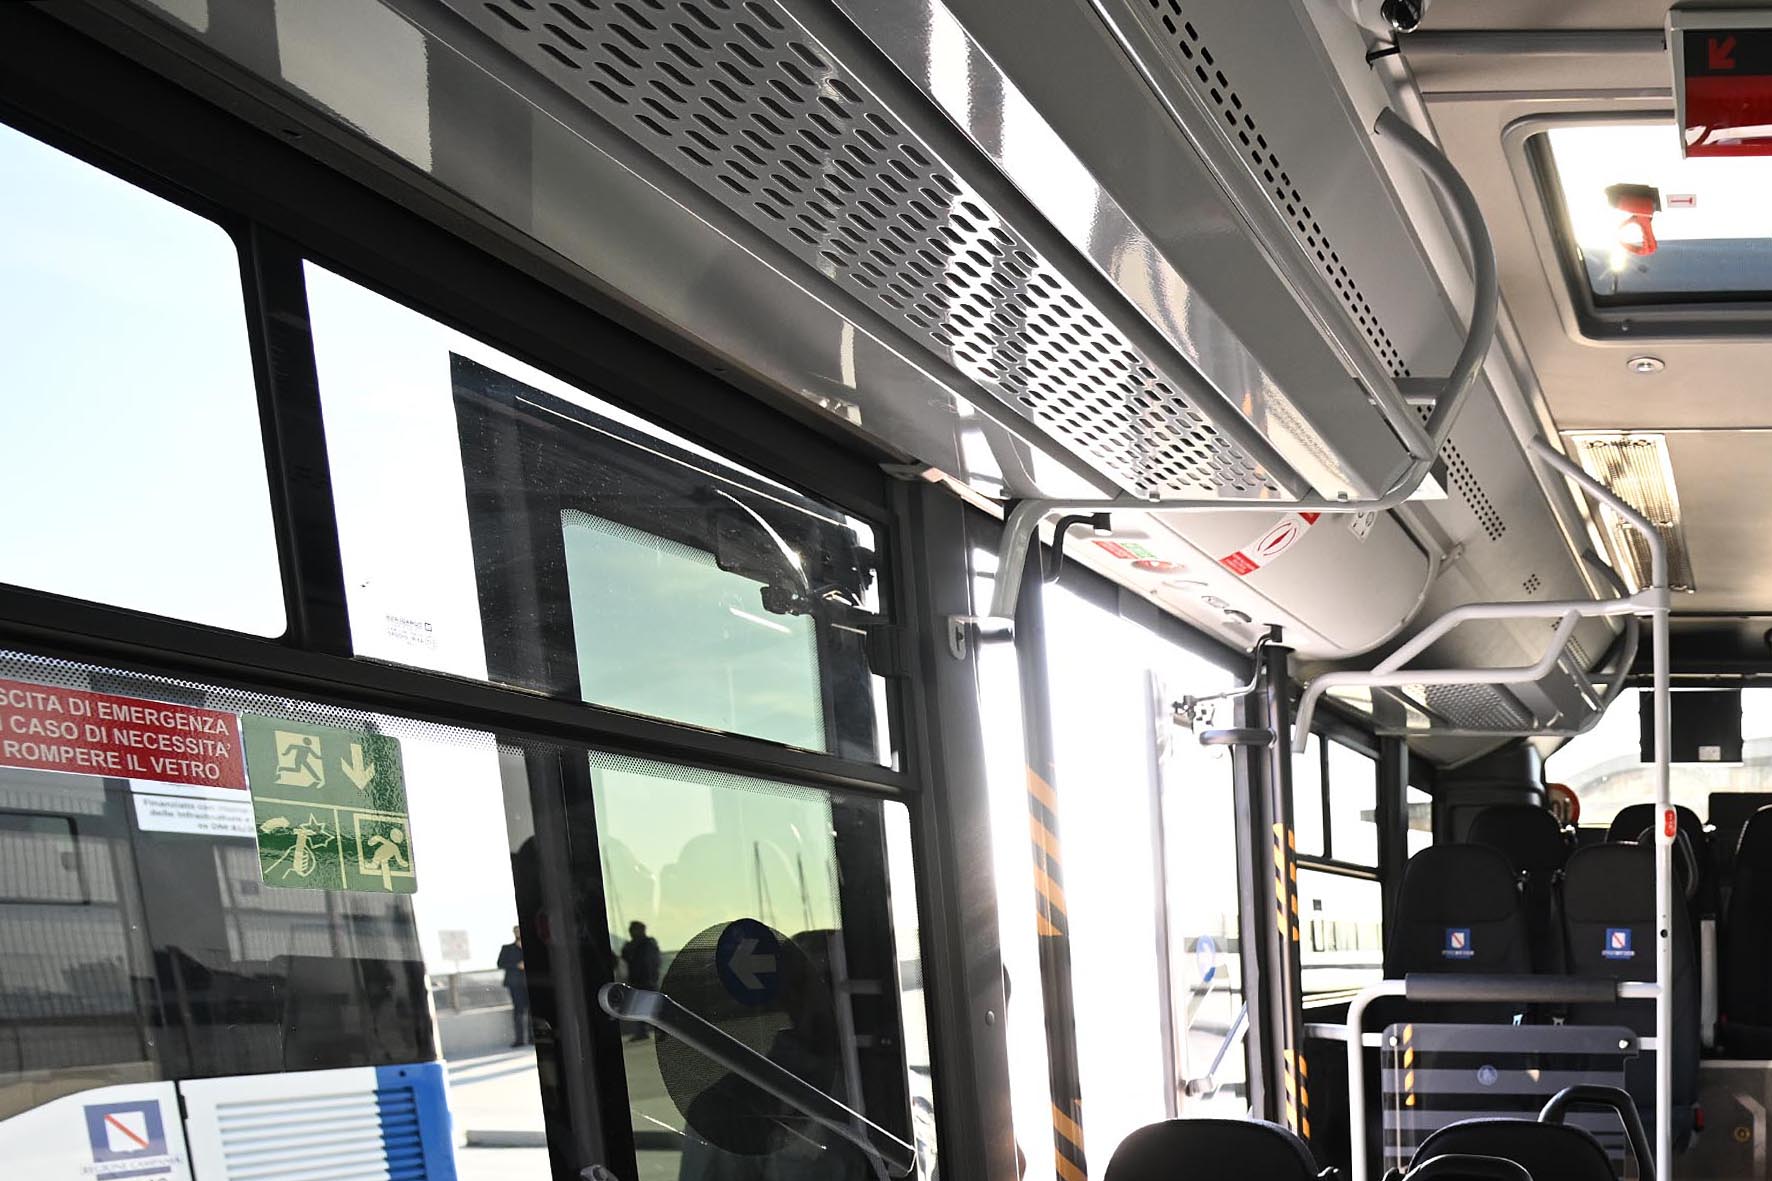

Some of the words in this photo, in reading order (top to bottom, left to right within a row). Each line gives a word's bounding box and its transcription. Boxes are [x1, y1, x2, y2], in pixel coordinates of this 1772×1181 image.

[10, 716, 78, 740] CASO
[85, 724, 107, 743] DI
[69, 698, 92, 717] DI
[99, 702, 230, 736] EMERGENZA
[3, 740, 121, 769] ROMPERE
[127, 753, 147, 772] IL
[150, 756, 221, 780] VETRO
